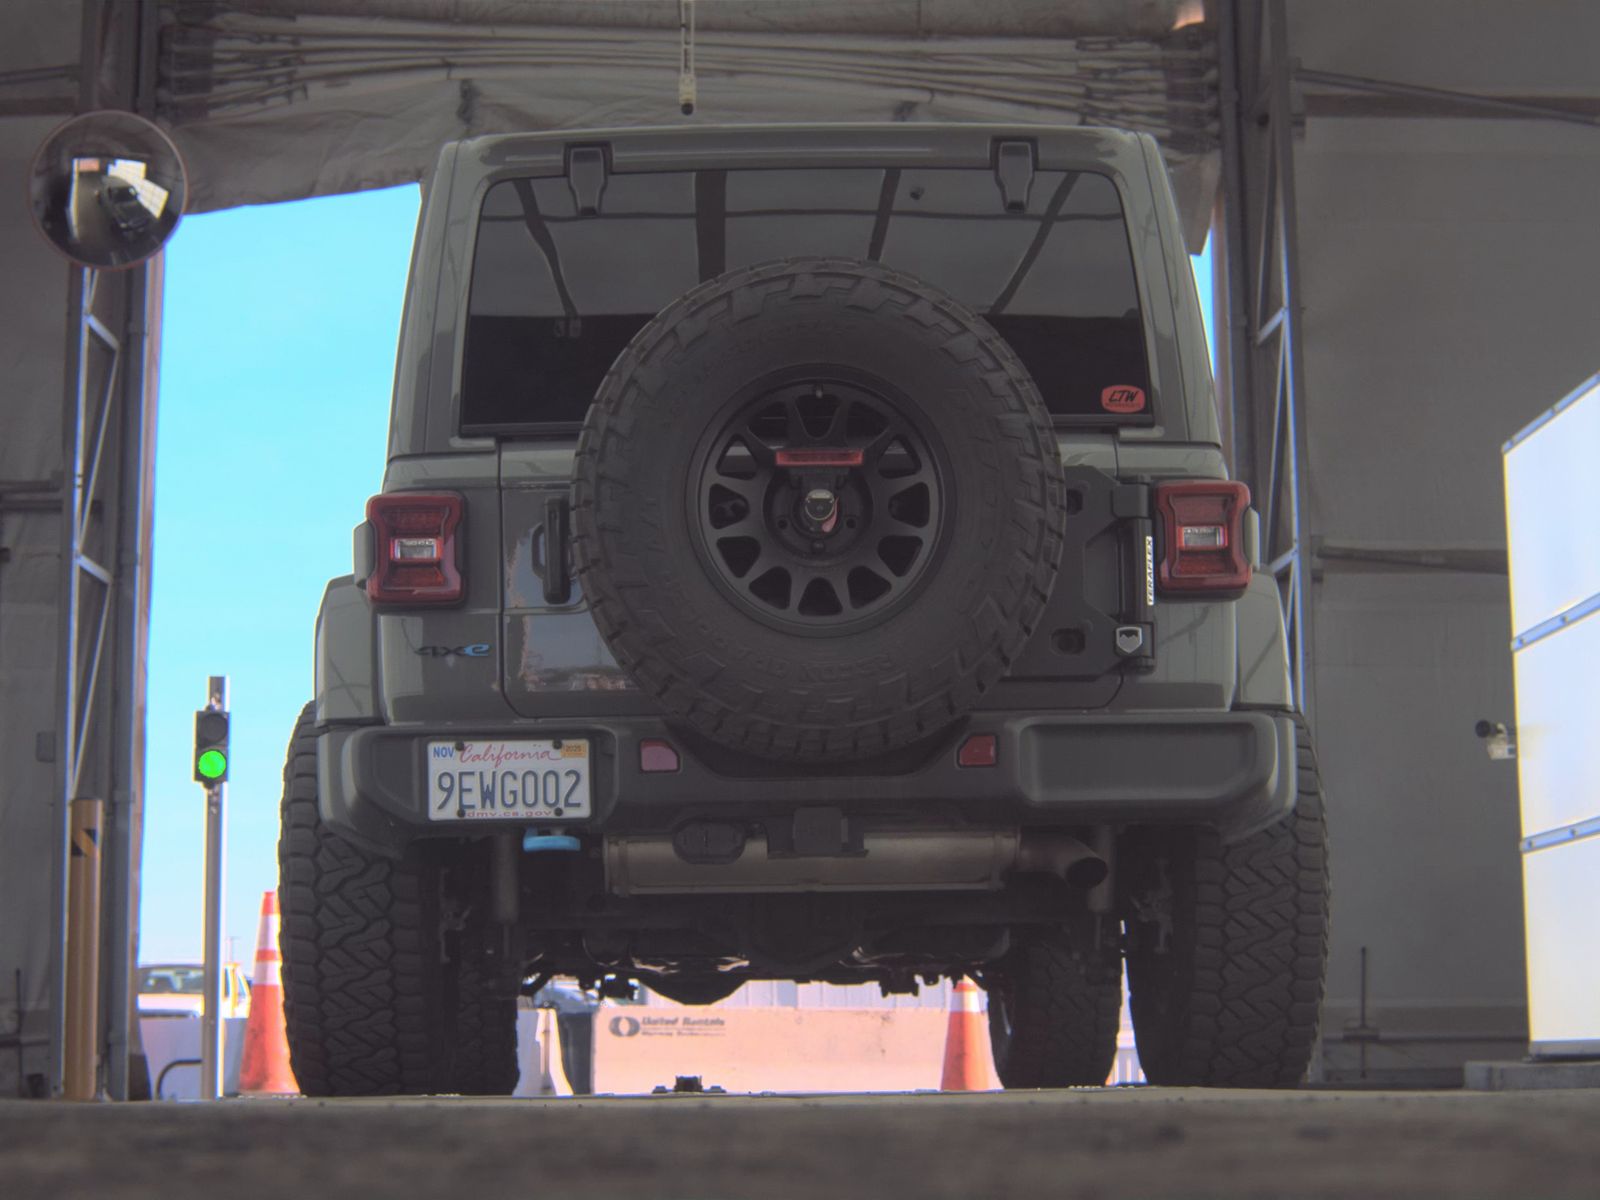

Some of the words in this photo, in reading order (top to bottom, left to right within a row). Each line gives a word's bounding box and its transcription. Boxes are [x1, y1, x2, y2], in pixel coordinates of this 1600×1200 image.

[433, 746, 455, 758] NOV
[460, 744, 562, 768] California
[438, 770, 581, 810] 9EWG002
